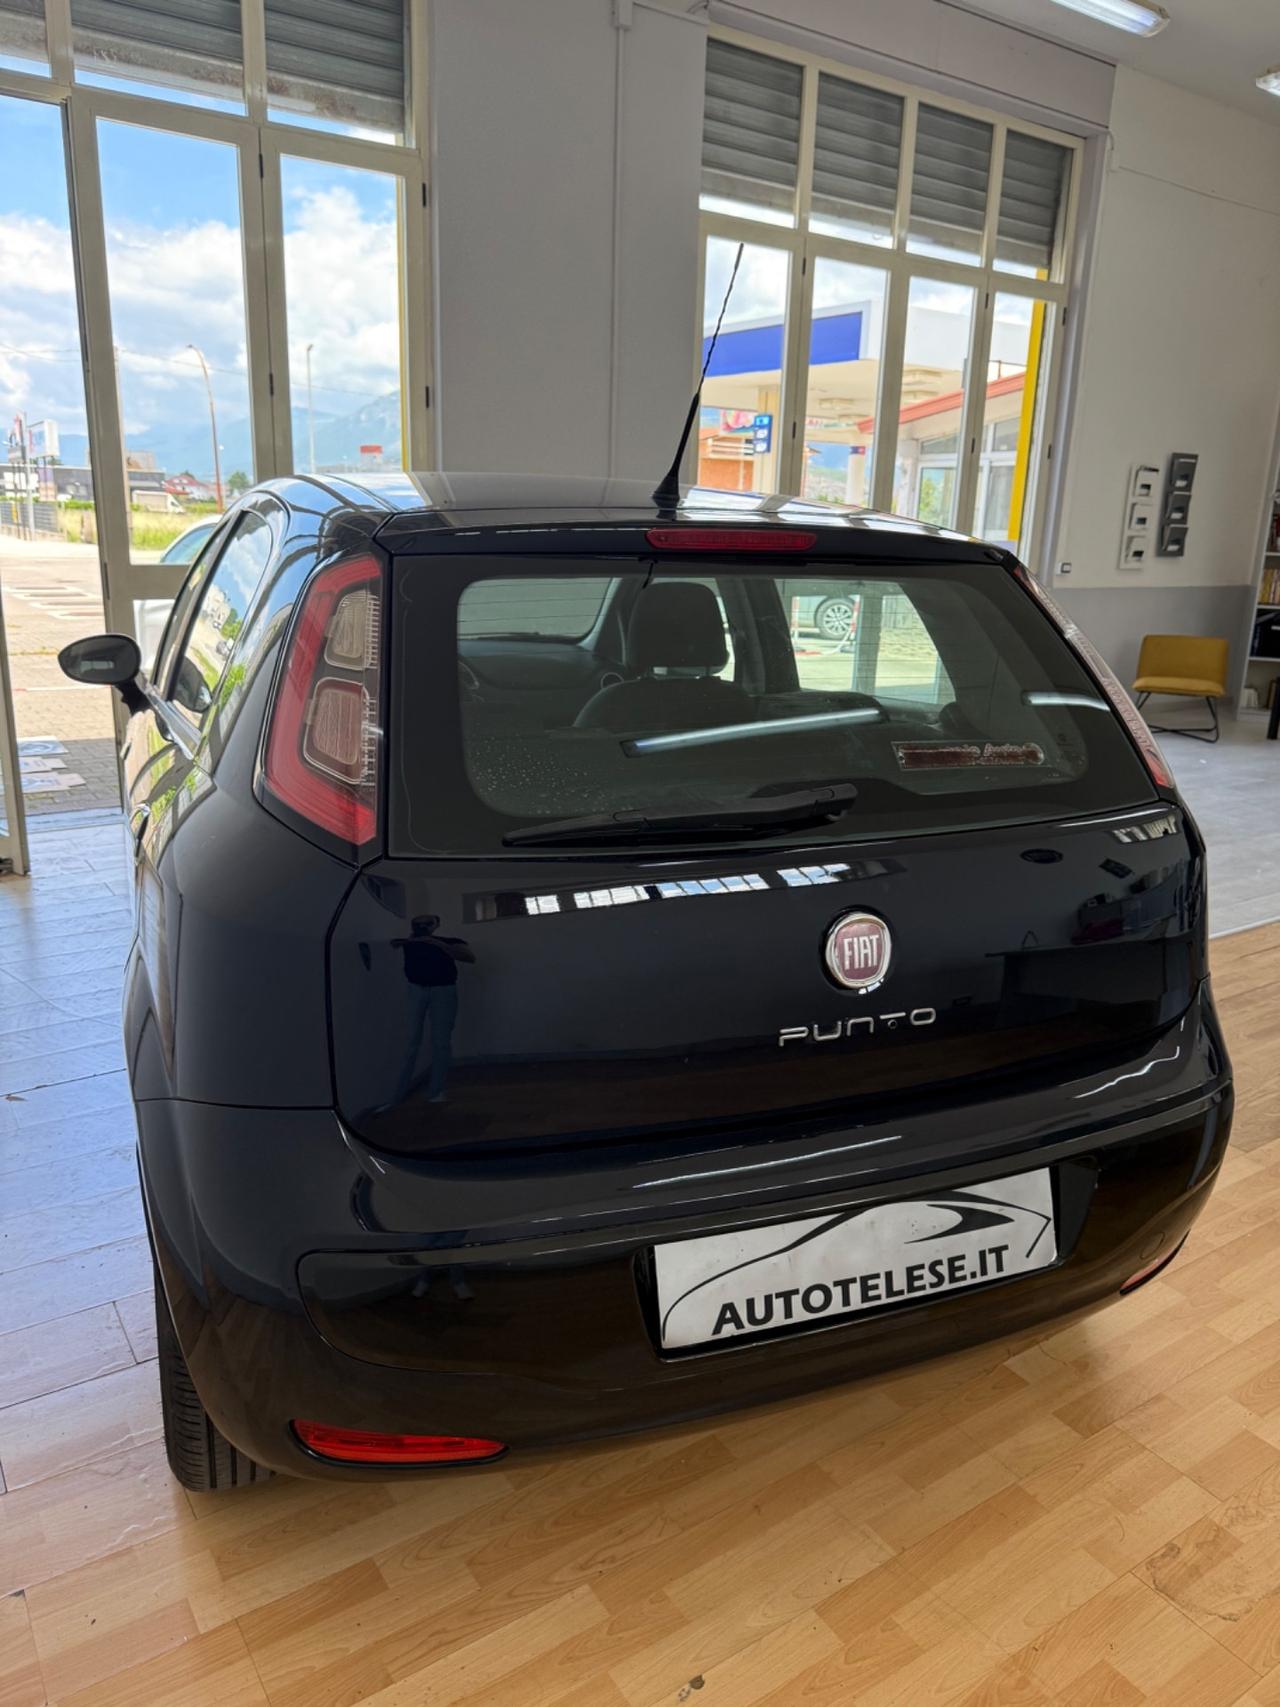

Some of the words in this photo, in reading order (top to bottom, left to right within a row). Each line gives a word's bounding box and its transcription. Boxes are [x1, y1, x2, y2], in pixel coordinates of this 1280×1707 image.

[843, 934, 879, 970] FIAT
[778, 1007, 937, 1047] PUNTO
[711, 1244, 1010, 1336] AUTOTELESE.IT
